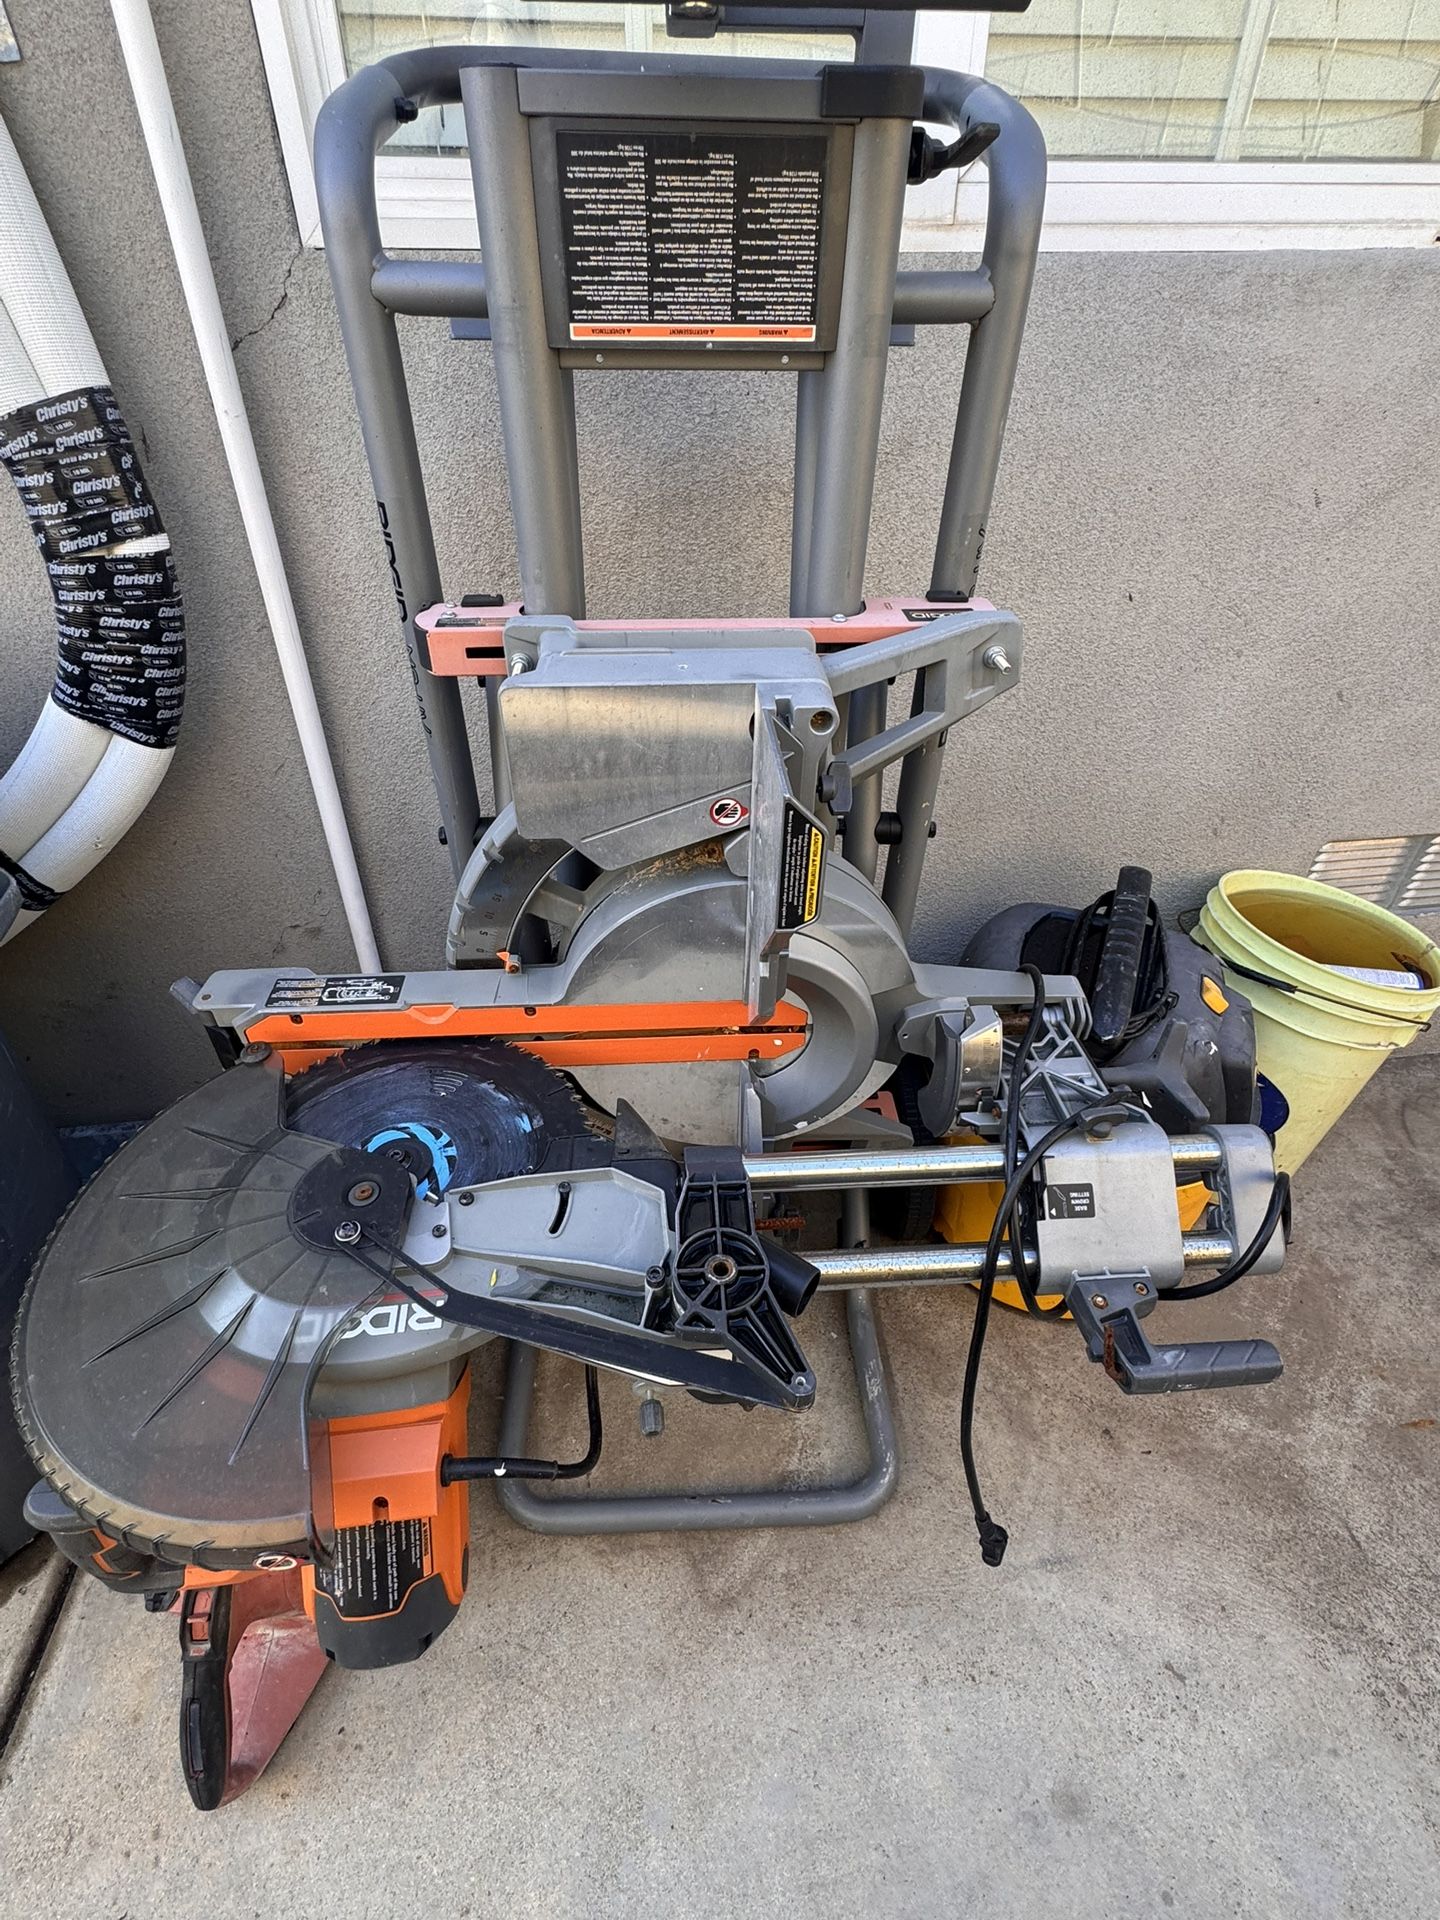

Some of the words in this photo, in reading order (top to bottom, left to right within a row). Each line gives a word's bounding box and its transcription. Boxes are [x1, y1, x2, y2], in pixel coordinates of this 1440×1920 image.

[36, 396, 88, 422] Christy's
[56, 427, 104, 452] Christy's
[73, 475, 121, 495] Christy's
[111, 504, 154, 524] Christy's
[59, 531, 108, 553] Christy's
[49, 563, 96, 575] Christy's
[113, 573, 164, 586] Christy's
[58, 590, 106, 601] Christy's
[99, 616, 151, 629] Christy's
[81, 652, 134, 665] Christy's
[110, 721, 157, 744] Christy's
